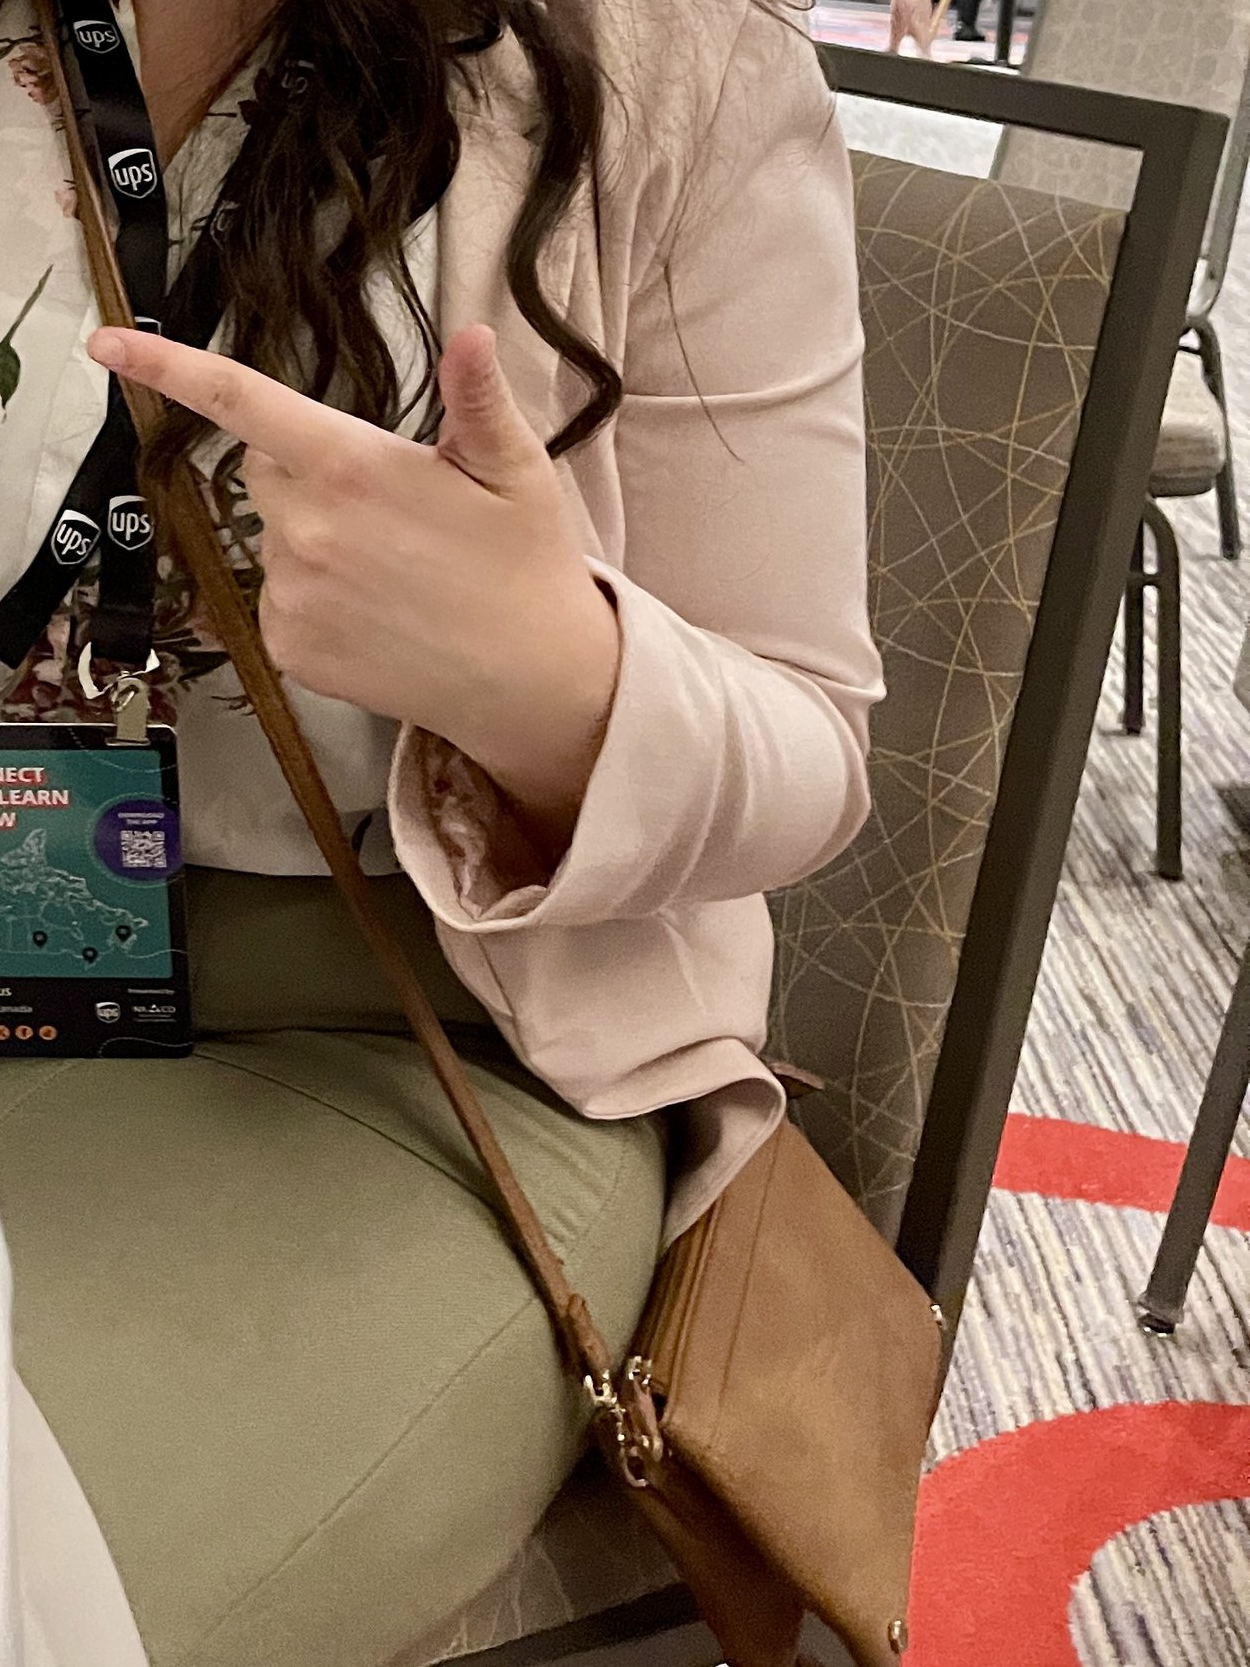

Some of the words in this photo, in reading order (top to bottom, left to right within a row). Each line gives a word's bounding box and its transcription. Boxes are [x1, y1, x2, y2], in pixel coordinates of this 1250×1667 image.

[79, 30, 116, 48] ups
[114, 163, 153, 191] ups
[56, 523, 92, 556] ups
[112, 512, 151, 541] ups
